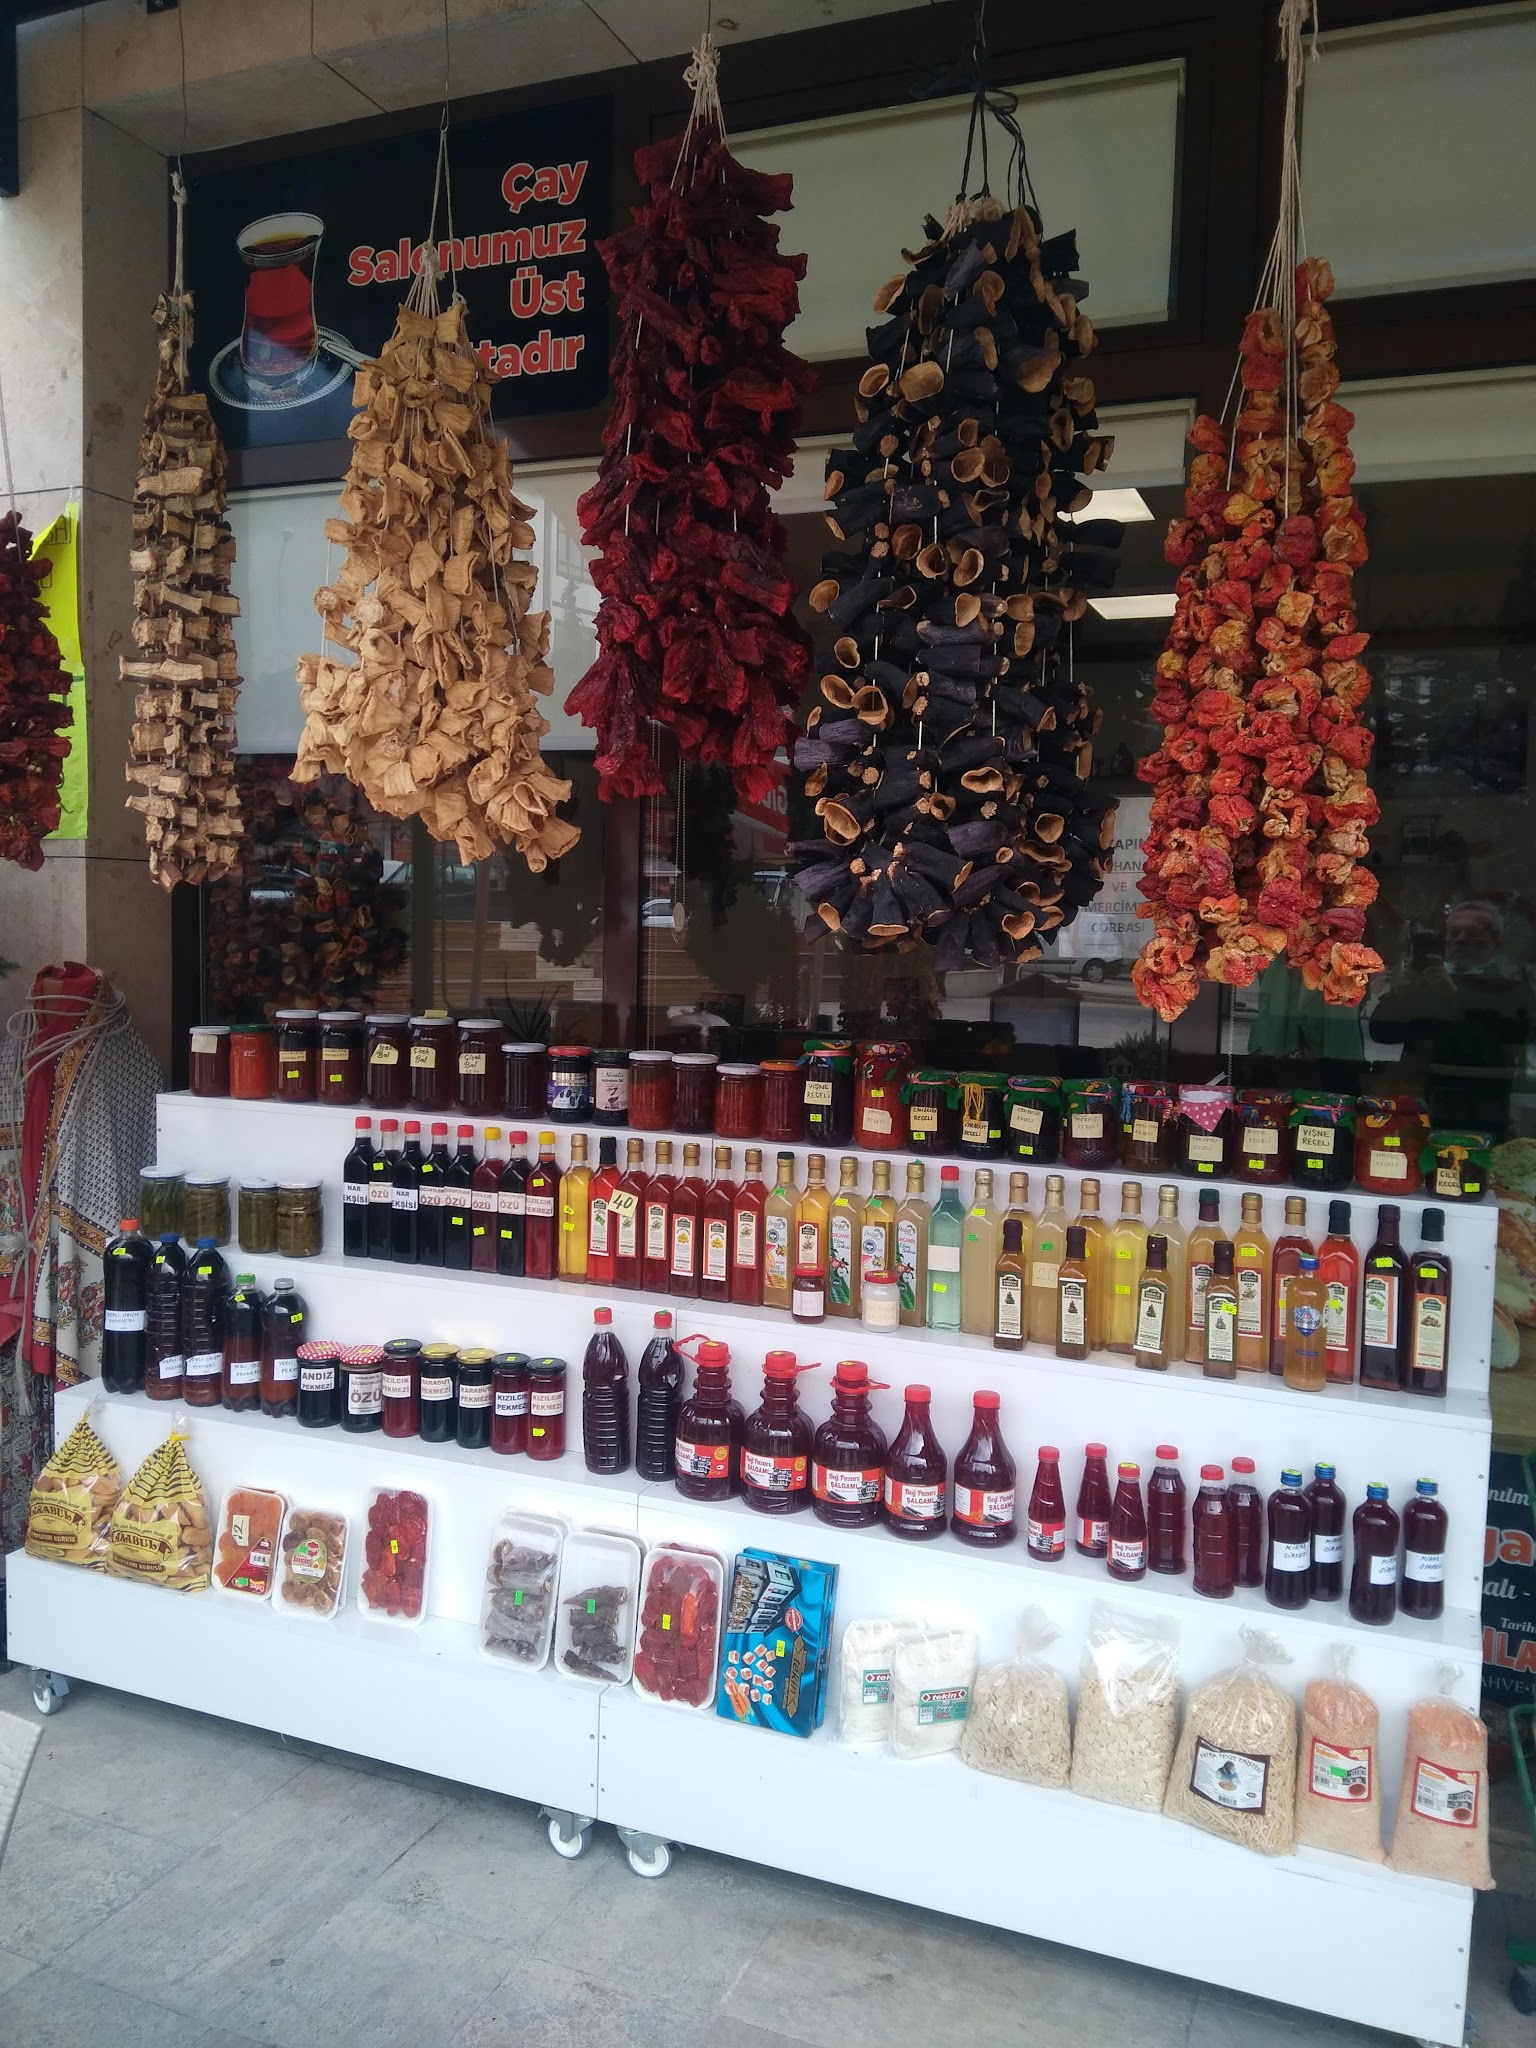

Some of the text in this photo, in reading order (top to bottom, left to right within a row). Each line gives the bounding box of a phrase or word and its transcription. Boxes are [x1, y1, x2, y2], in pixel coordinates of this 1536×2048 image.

[502, 160, 589, 214] Çay
[347, 218, 586, 286] Salonumuz
[509, 265, 585, 319] Üst
[1112, 881, 1127, 892] VE
[415, 1055, 428, 1063] Bal
[1303, 1129, 1330, 1138] VİŞNE
[1302, 1137, 1330, 1146] REÇELİ
[371, 1189, 389, 1198] ÖZÜ
[420, 1194, 441, 1205] ÖZÜ
[445, 1195, 466, 1207] ÖZÜ
[473, 1199, 491, 1210] ÖZÜ
[500, 1200, 519, 1210] ÖZÜ
[613, 1194, 634, 1209] 40
[302, 1371, 333, 1381] ANDIZ
[351, 1388, 381, 1403] ÖZÜ
[1500, 1617, 1536, 1634] Tarih
[932, 1692, 957, 1701] tekin
